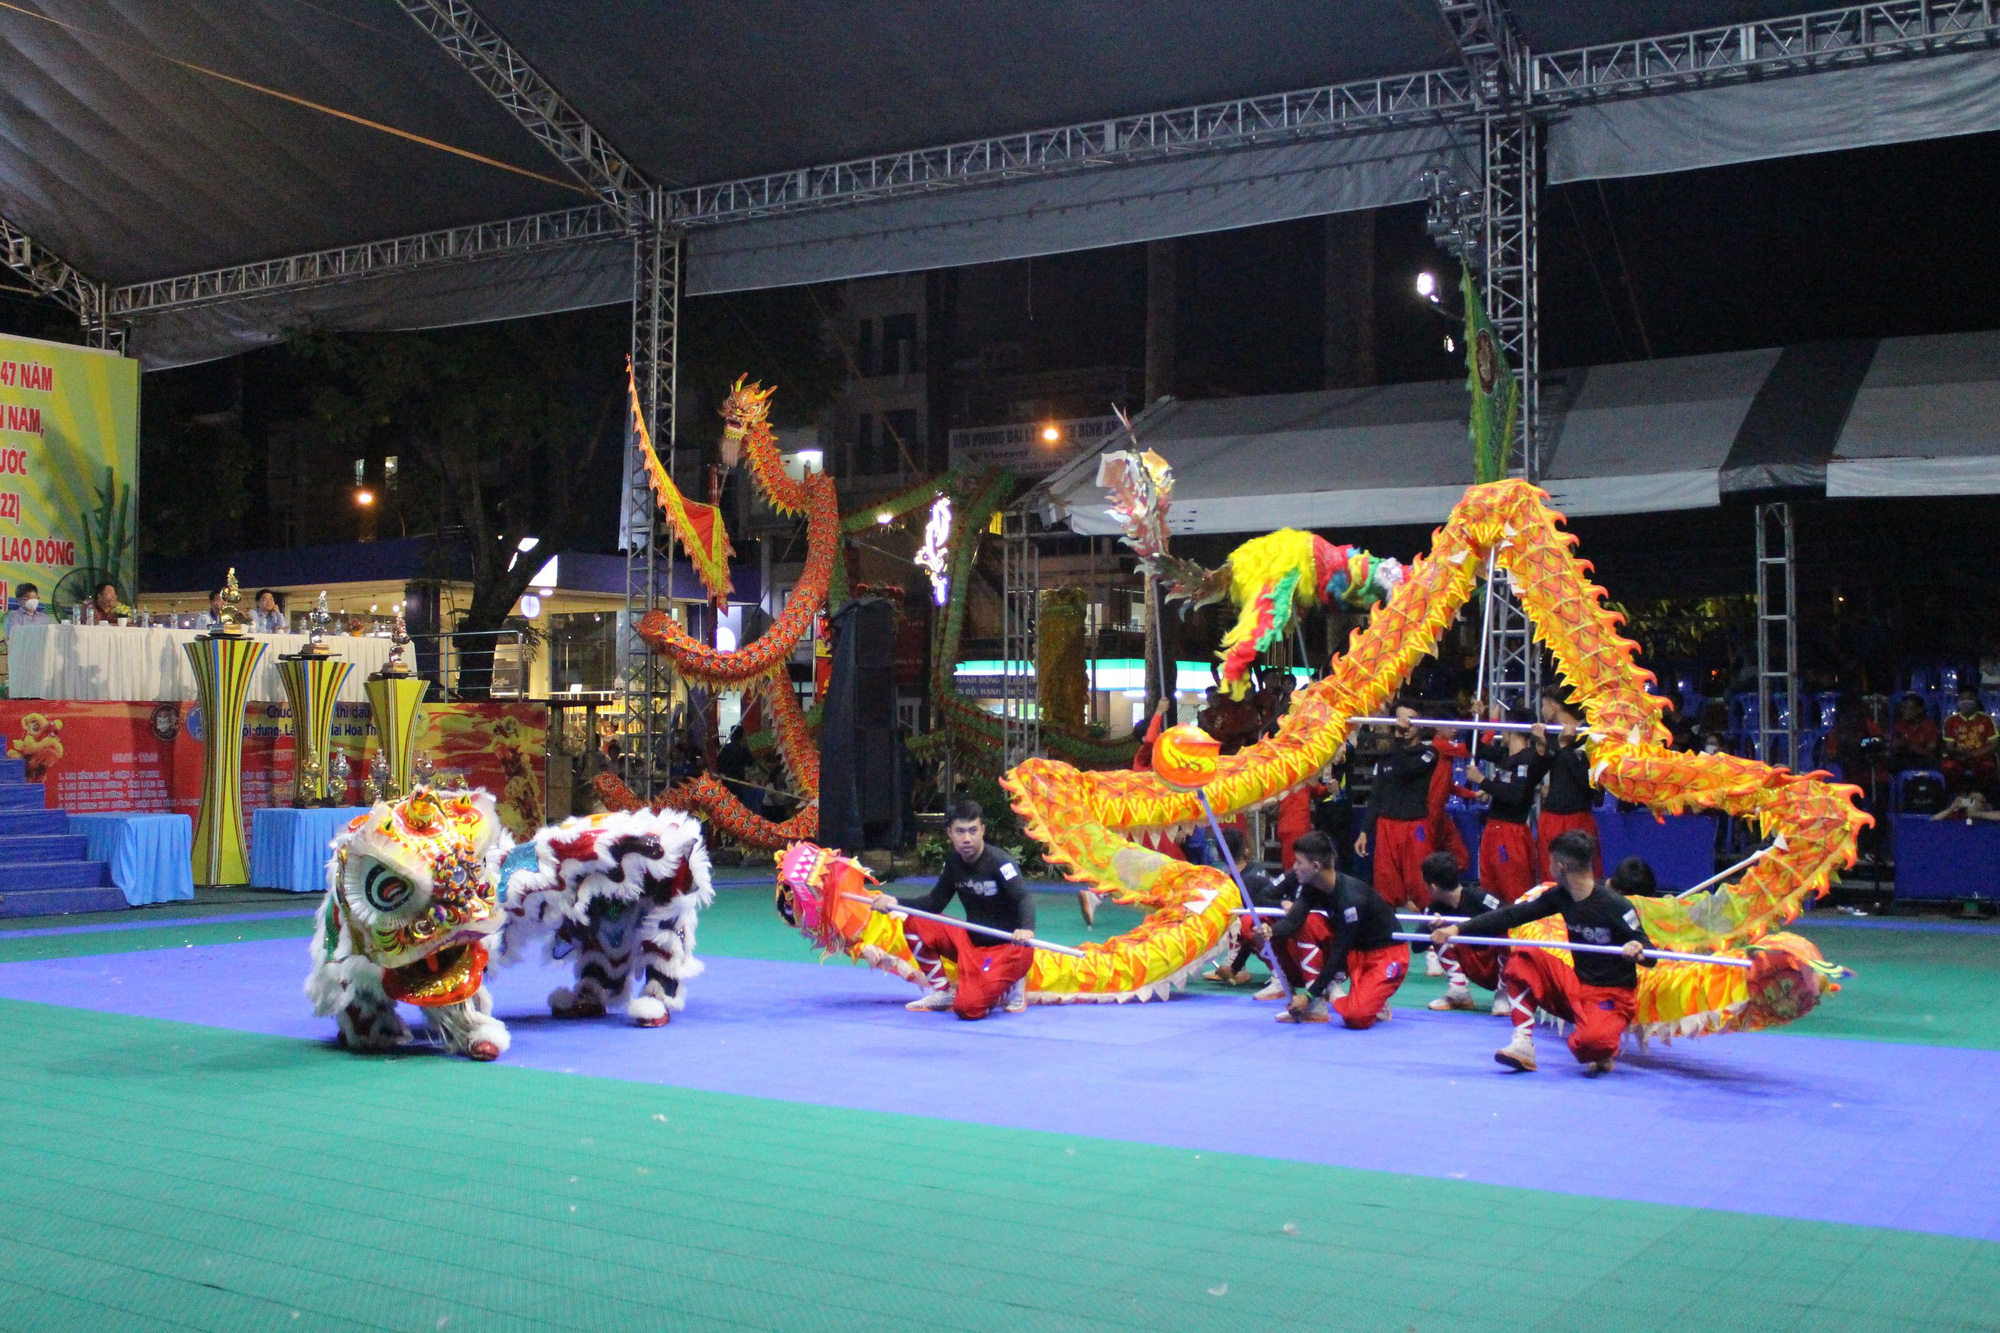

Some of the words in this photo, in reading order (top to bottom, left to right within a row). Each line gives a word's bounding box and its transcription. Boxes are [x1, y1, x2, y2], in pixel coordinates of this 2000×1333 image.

[1, 361, 16, 386] 47
[21, 361, 52, 391] NĂM
[2, 537, 31, 563] LAO
[36, 536, 74, 569] ĐỘNG
[345, 723, 362, 736] Hoa
